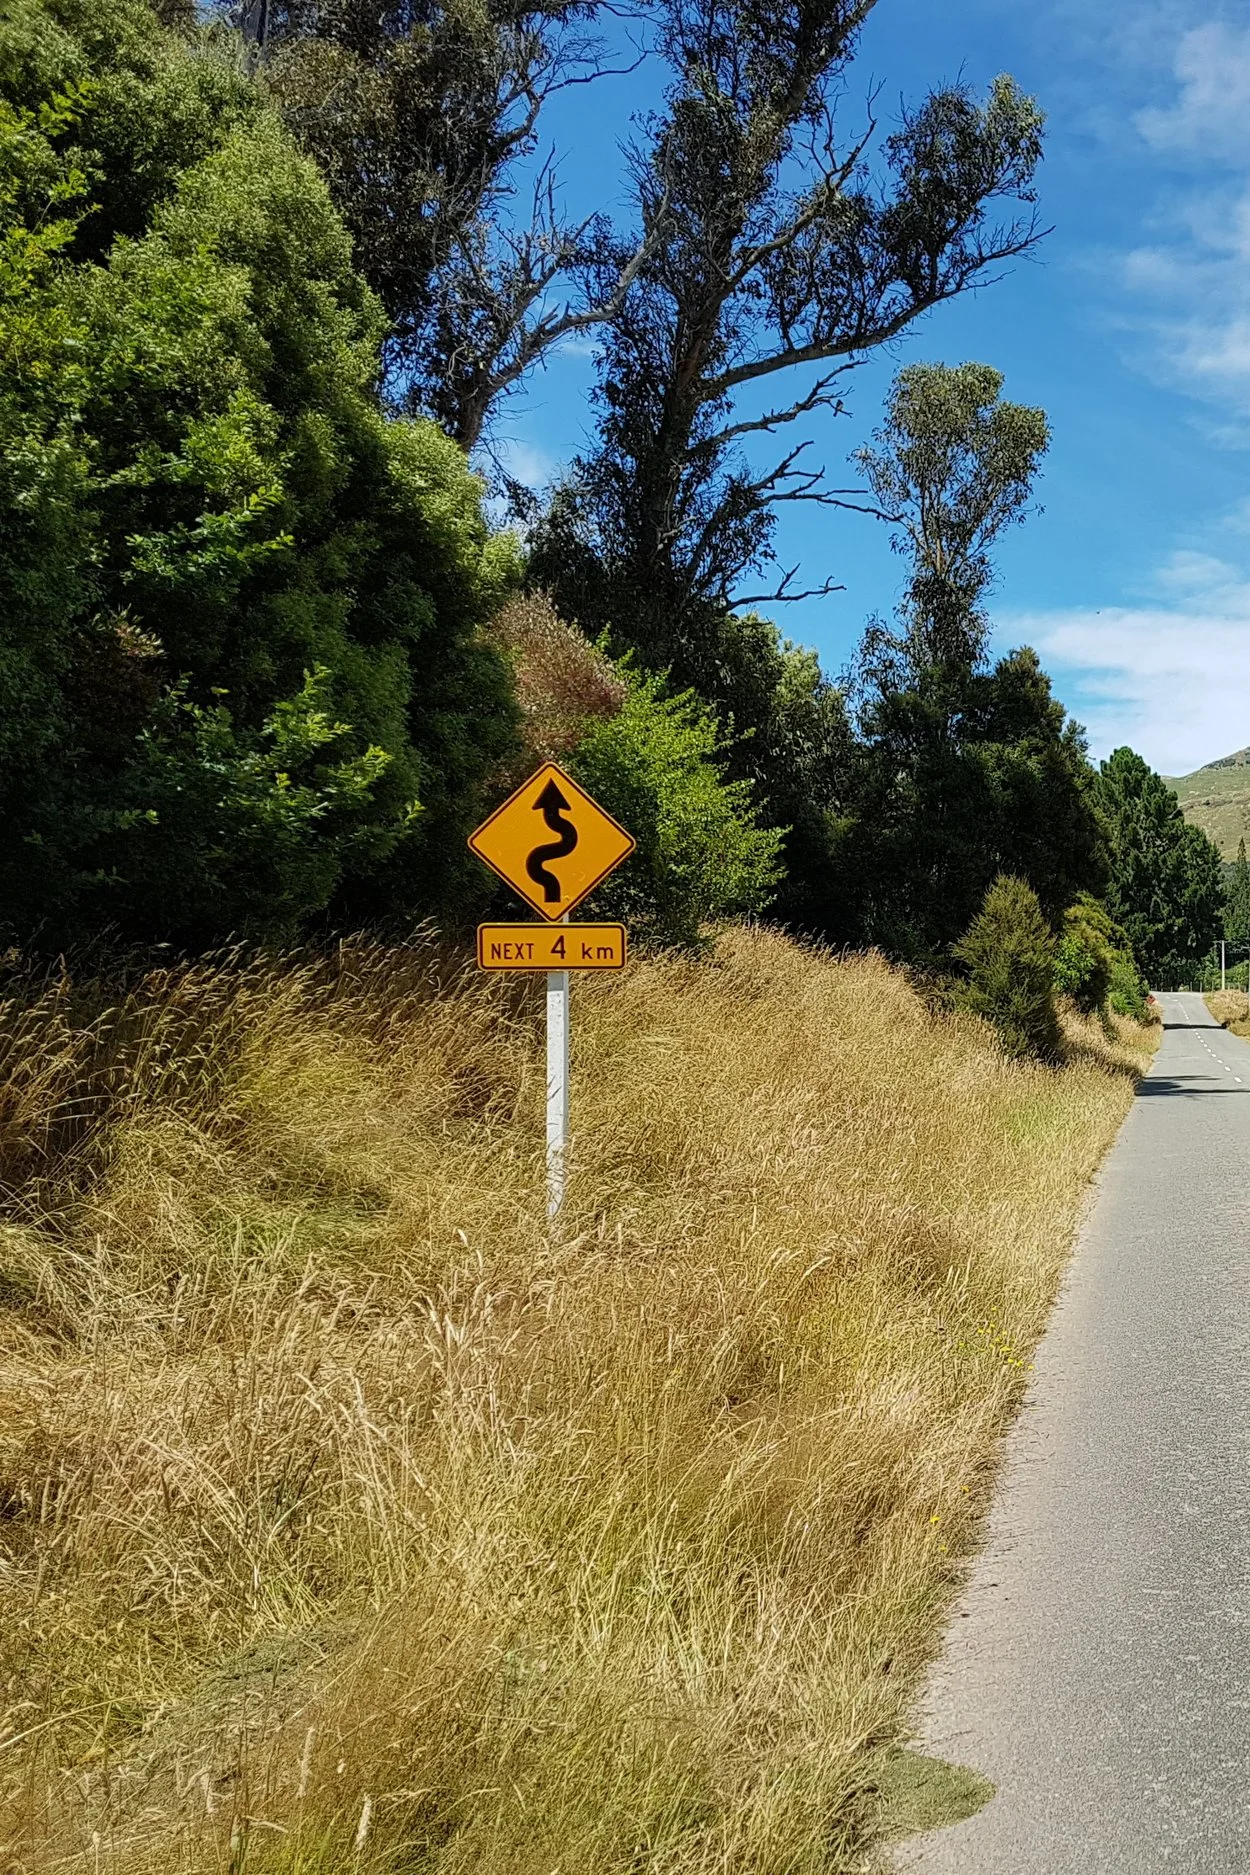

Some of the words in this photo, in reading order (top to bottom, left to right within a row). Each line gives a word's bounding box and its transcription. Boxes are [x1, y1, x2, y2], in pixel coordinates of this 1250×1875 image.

[491, 943, 534, 960] NEXT
[550, 935, 566, 960] 4
[581, 943, 614, 960] km
